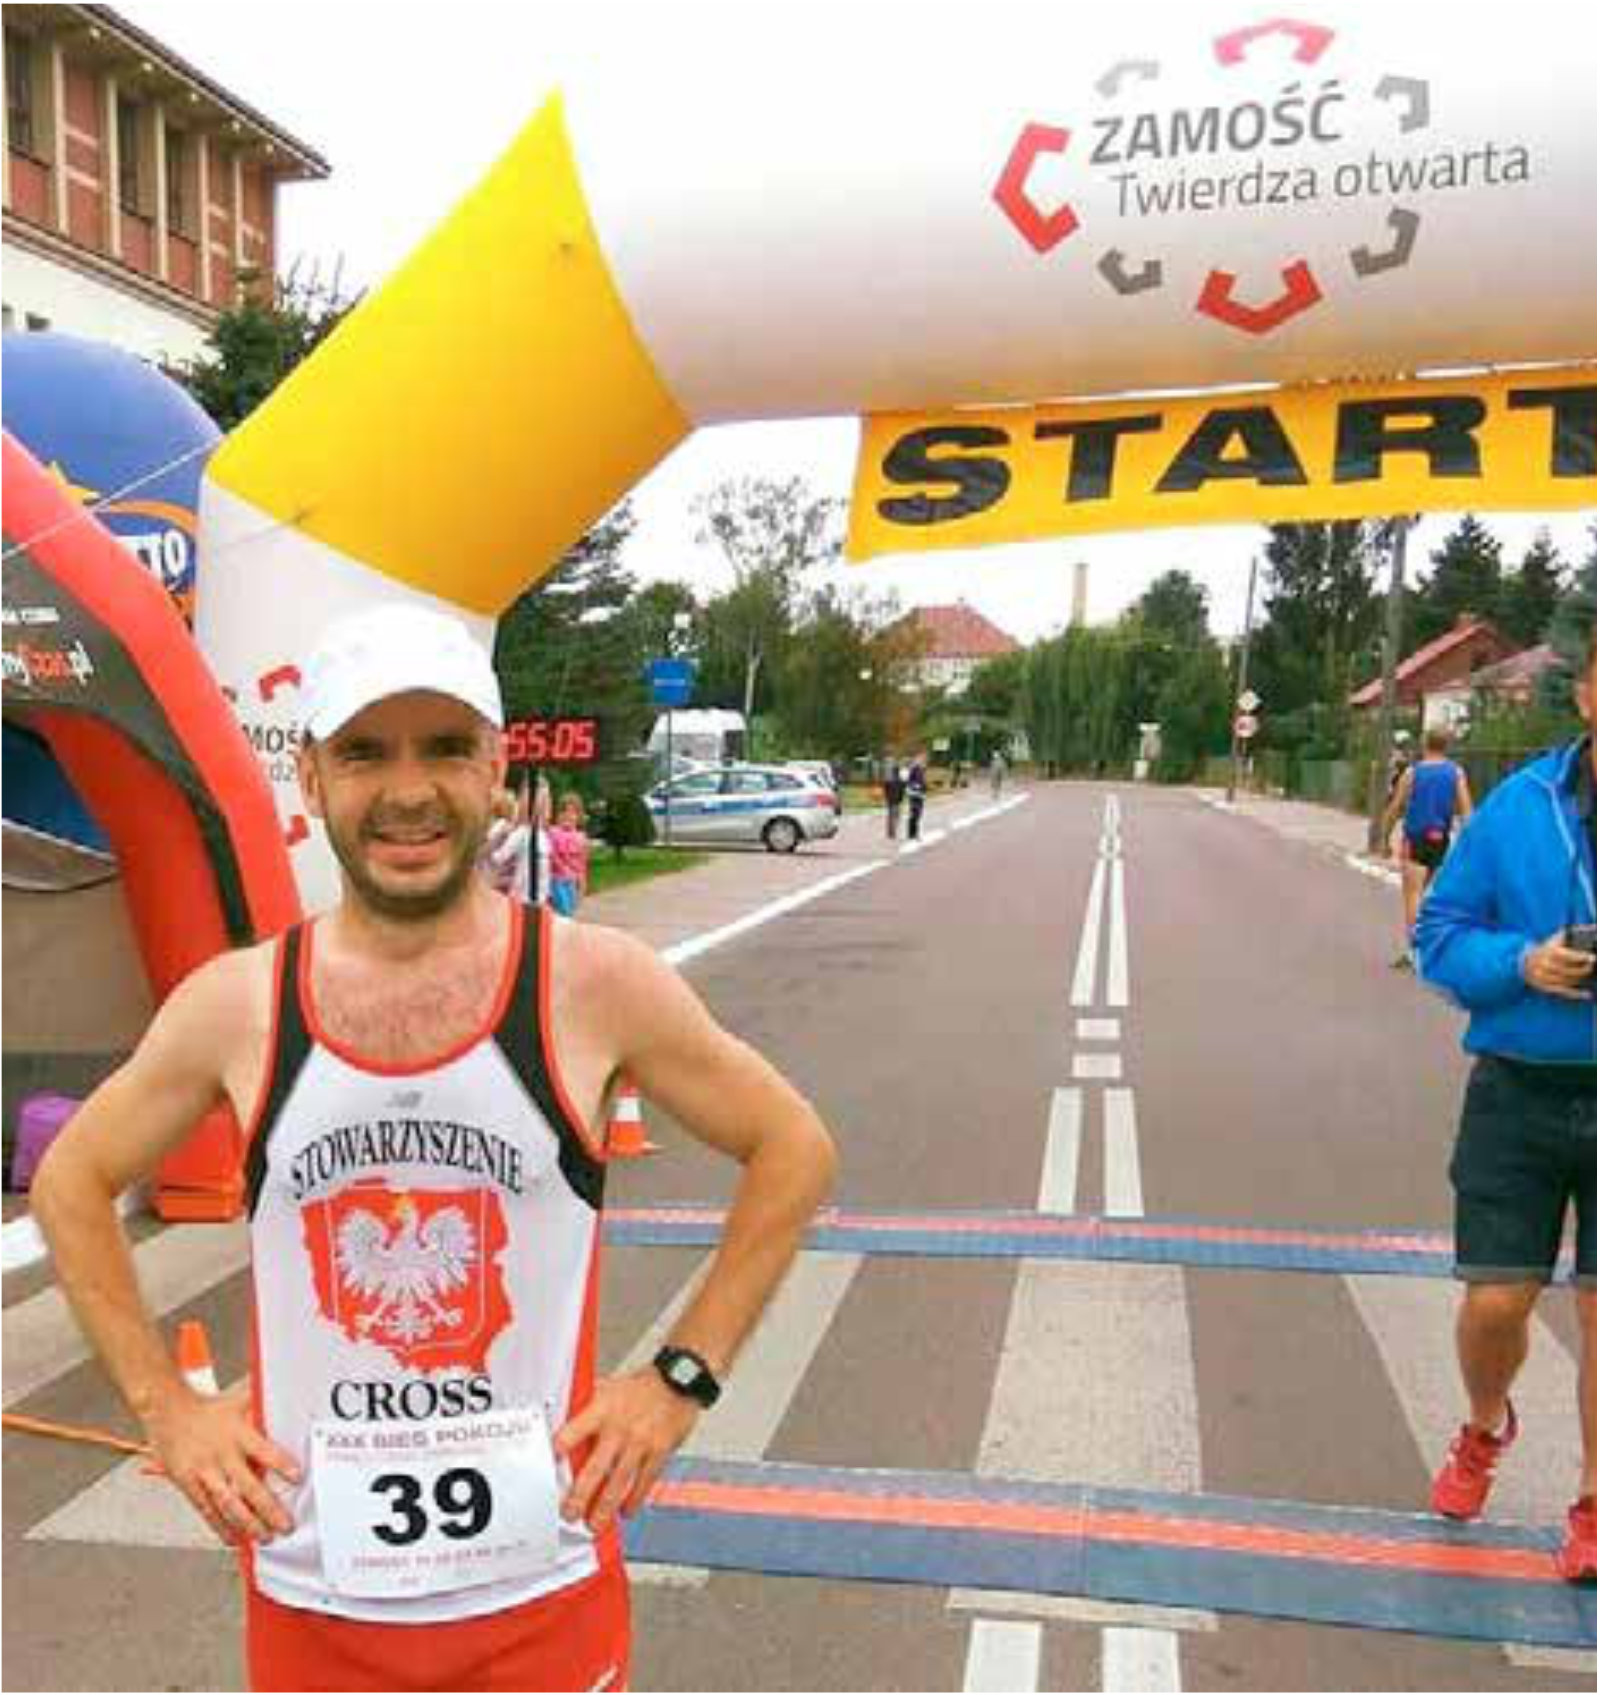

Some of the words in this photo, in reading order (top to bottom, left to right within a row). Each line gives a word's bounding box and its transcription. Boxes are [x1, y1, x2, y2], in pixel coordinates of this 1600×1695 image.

[1089, 79, 1345, 165] ZAMOŚĆ
[1109, 159, 1317, 217] Twierdza
[1334, 142, 1529, 197] otwarta
[877, 386, 1597, 525] START
[290, 1119, 523, 1200] STOWARZYSZENIE
[330, 1376, 493, 1422] CROSS
[370, 1467, 493, 1546] 39
